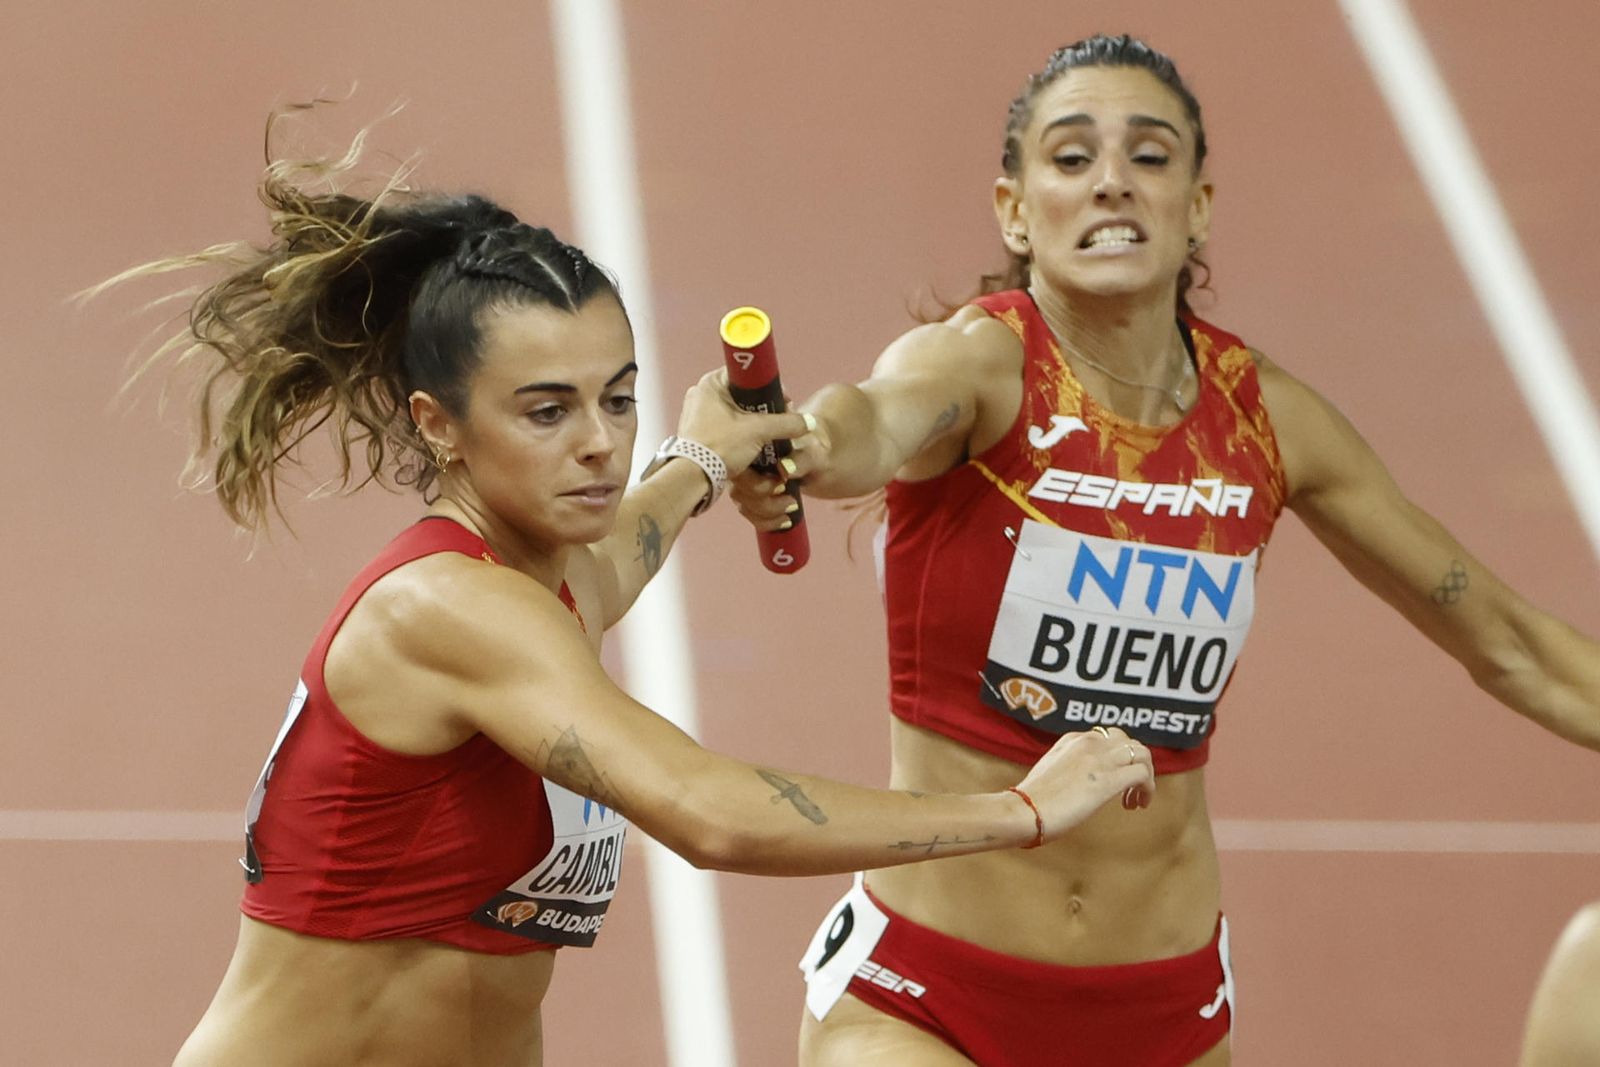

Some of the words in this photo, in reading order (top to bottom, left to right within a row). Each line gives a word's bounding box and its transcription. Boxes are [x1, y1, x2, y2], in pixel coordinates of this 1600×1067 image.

[1028, 467, 1253, 518] ESPAÑA
[1067, 540, 1242, 622] NTN
[1028, 614, 1228, 694] BUENO
[1064, 699, 1201, 735] BUDAPEST
[814, 901, 855, 971] 9
[853, 959, 927, 998] ESP
